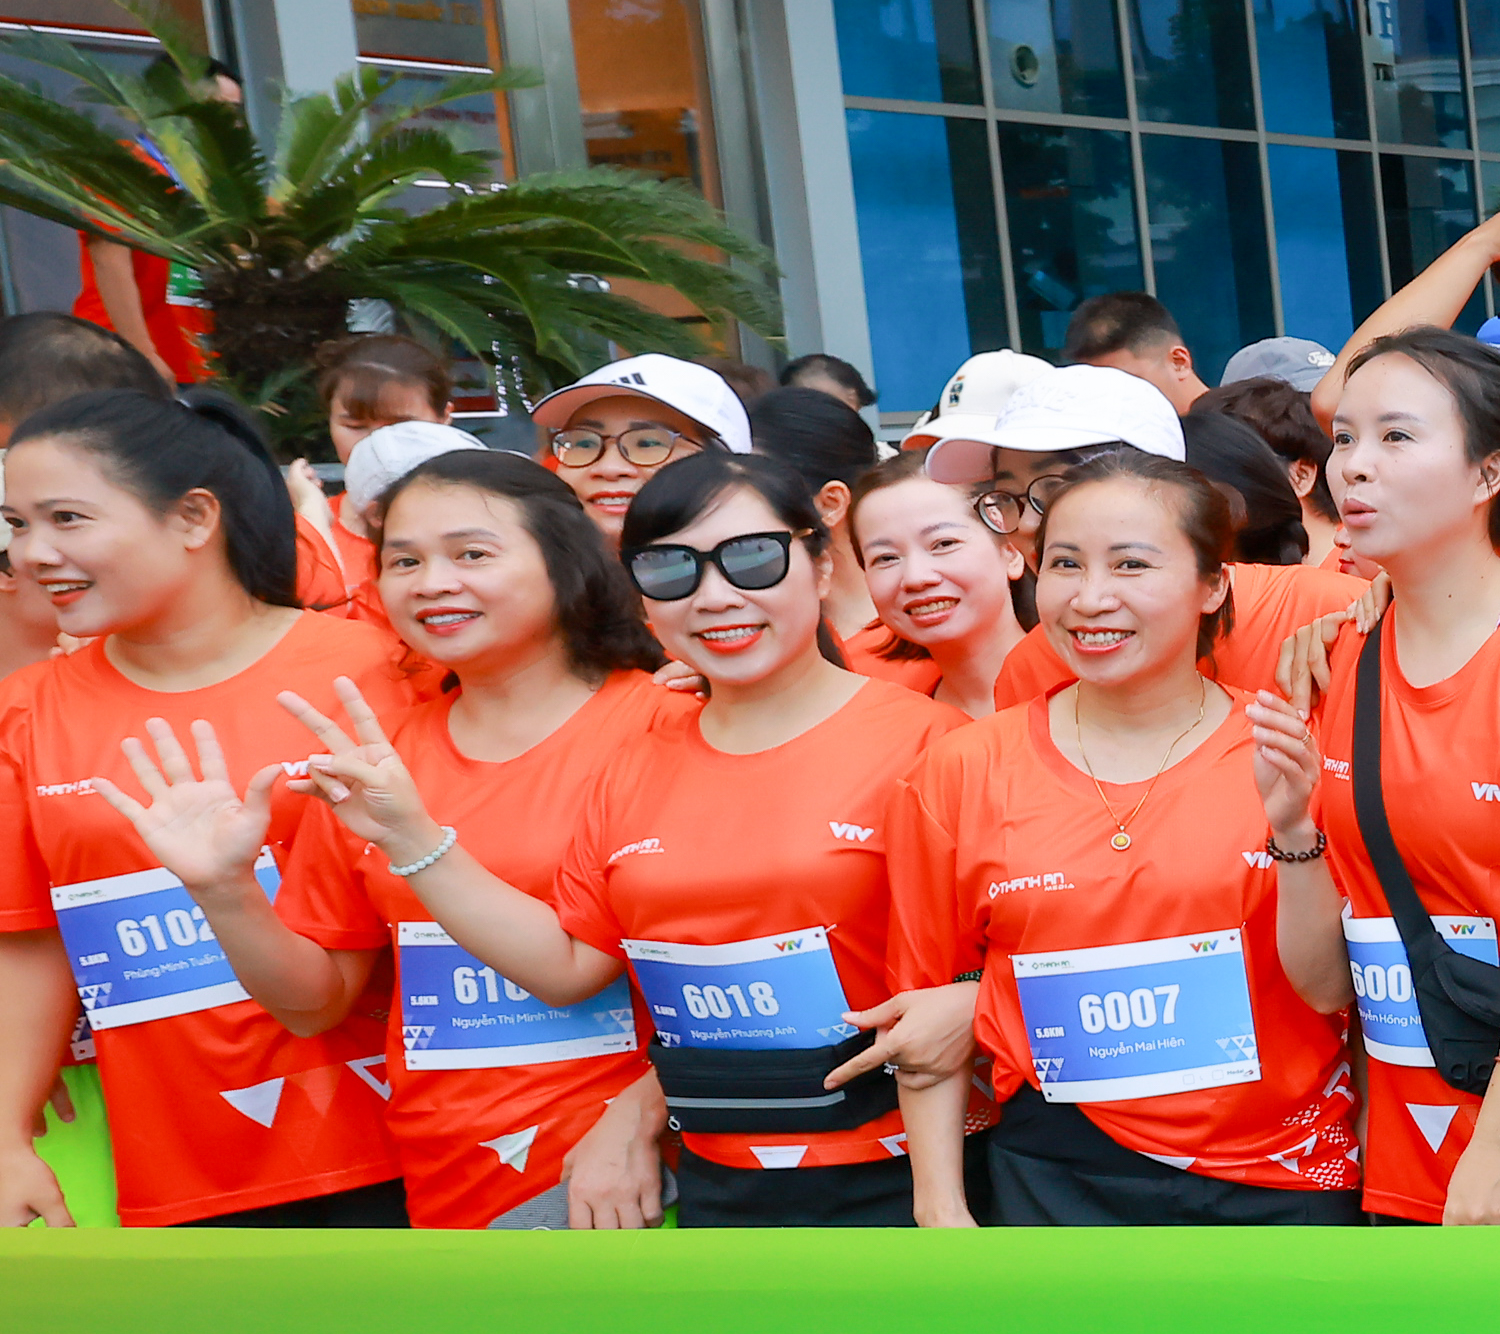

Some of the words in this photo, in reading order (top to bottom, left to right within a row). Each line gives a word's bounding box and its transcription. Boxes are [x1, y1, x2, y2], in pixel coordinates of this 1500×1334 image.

[281, 760, 311, 777] VT
[829, 821, 875, 842] VTV
[999, 875, 1042, 894] THANH
[1043, 871, 1065, 886] AN
[1045, 884, 1076, 892] MEDIA
[1449, 924, 1477, 935] VTV
[773, 938, 804, 952] VTV
[1189, 939, 1219, 953] VTV
[1350, 960, 1413, 1003] 600
[682, 980, 781, 1020] 6018
[1078, 983, 1181, 1035] 6007
[452, 1013, 499, 1029] Nguyễn
[499, 1014, 517, 1026] Thị
[518, 1011, 547, 1023] Minh
[1035, 1026, 1066, 1039] 5.6KM
[1089, 1042, 1135, 1059] Nguyễn
[1135, 1039, 1157, 1052] Mai
